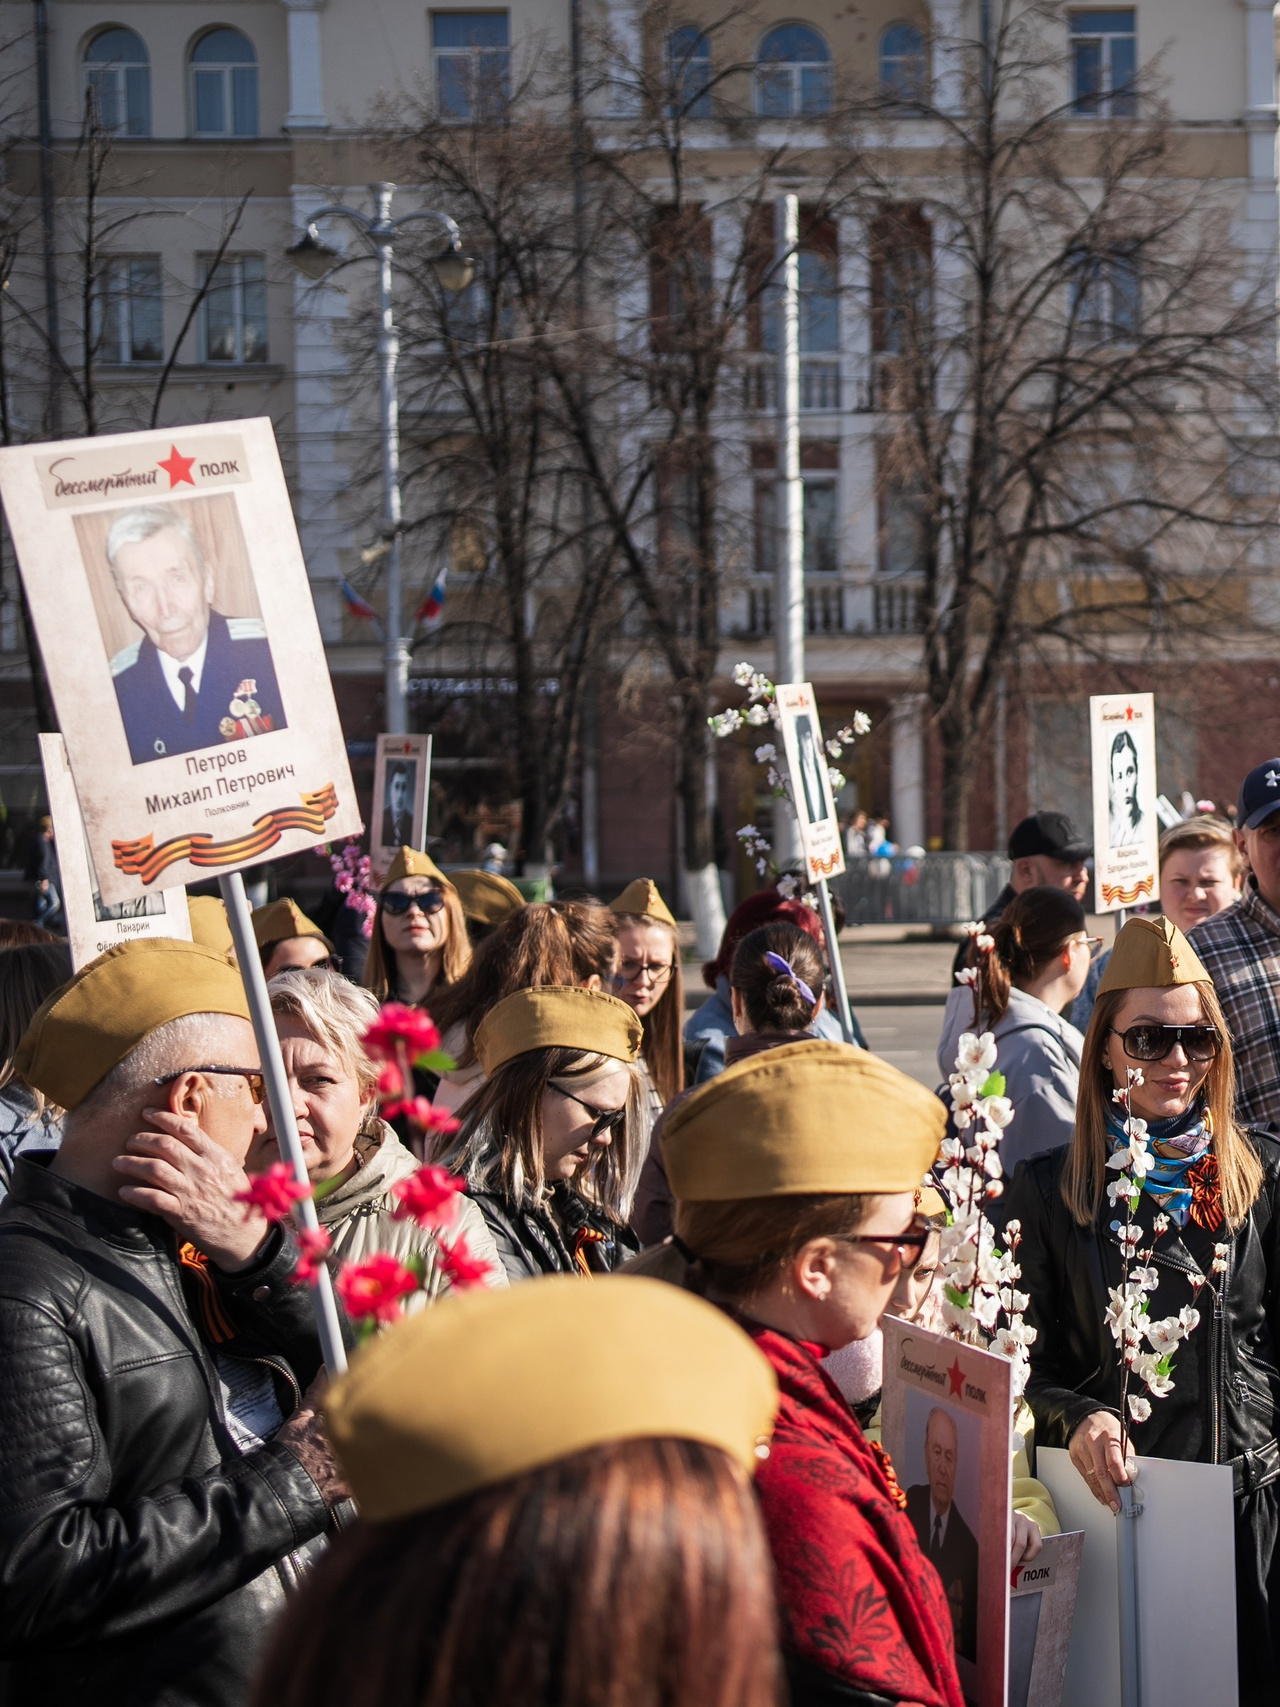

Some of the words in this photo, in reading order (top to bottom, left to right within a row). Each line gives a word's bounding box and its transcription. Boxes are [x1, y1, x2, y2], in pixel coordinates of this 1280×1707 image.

[186, 749, 247, 776] Петров
[145, 786, 213, 815] Михаил
[216, 764, 296, 796] Петрович
[204, 800, 251, 818] Полковник
[116, 921, 151, 934] Панарин
